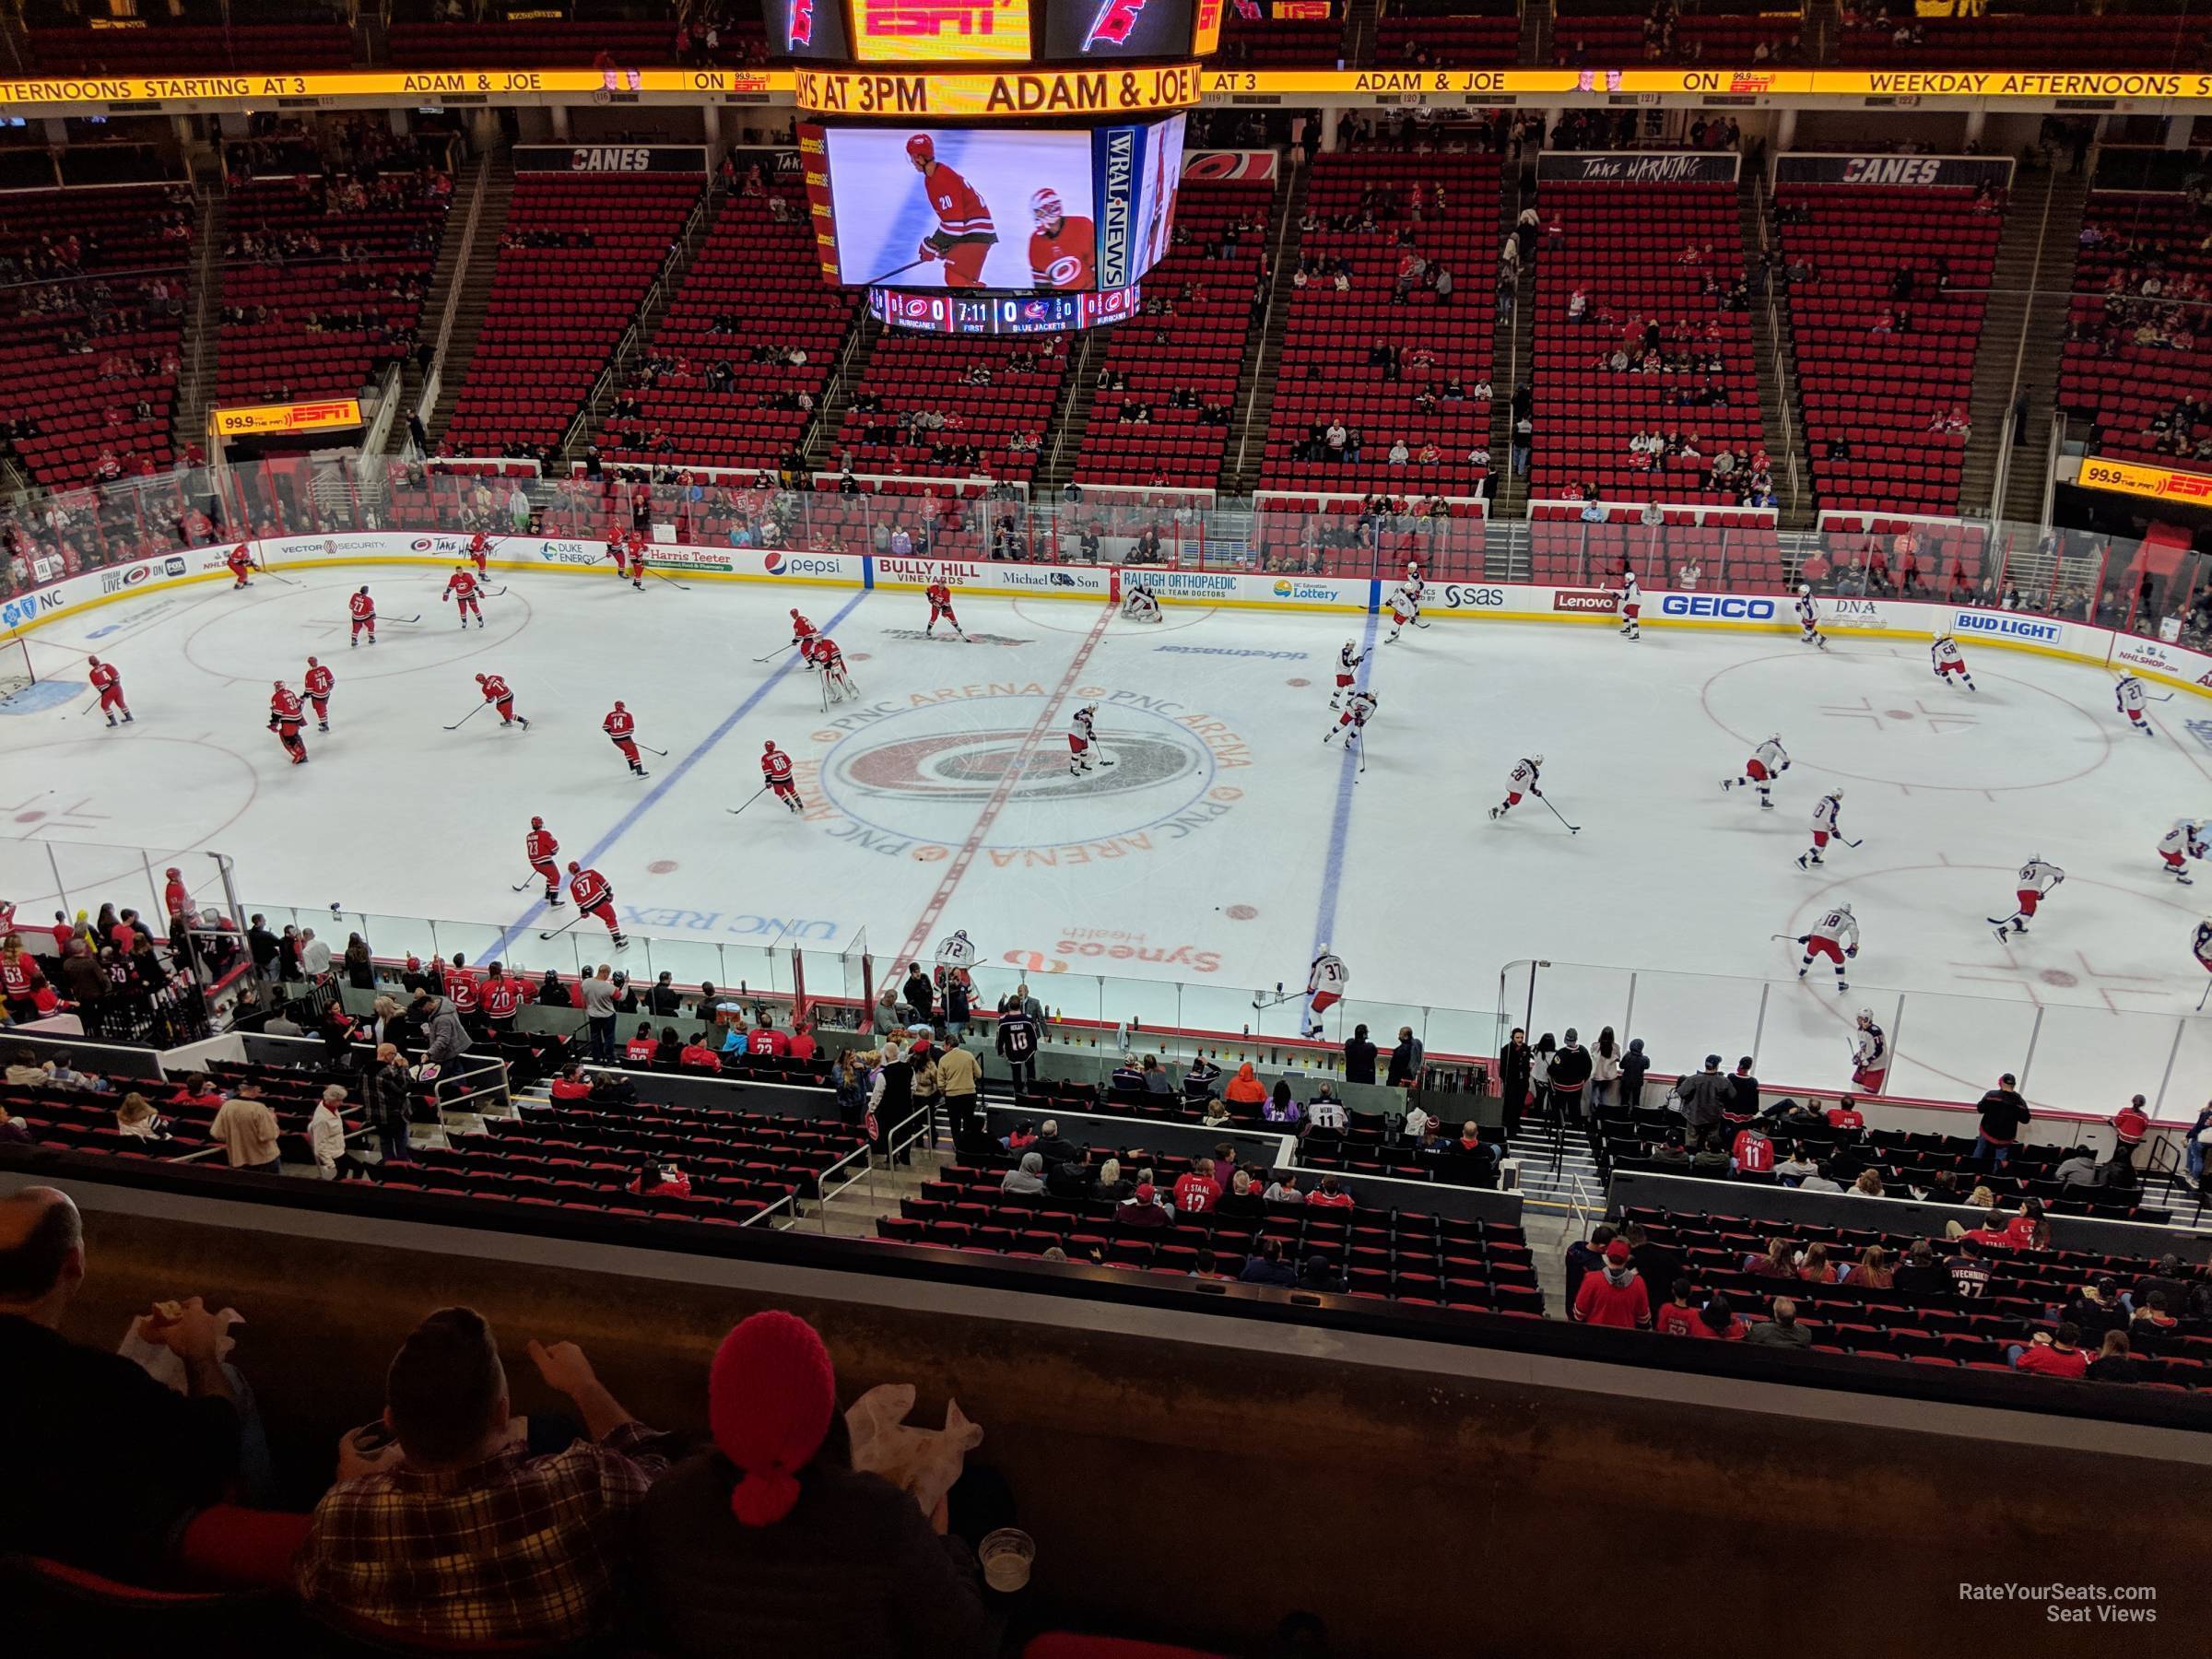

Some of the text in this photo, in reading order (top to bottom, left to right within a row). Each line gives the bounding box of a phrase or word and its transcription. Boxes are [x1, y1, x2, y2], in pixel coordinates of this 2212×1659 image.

[145, 78, 250, 97] STARTING
[263, 77, 287, 95] AT
[293, 77, 306, 94] 3
[404, 74, 542, 91] ADAM & JOE
[695, 74, 724, 88] ON
[1214, 73, 1505, 90] AT 3 ADAM & JOE
[1684, 73, 1719, 90] ON
[1870, 75, 1990, 92] WEEKDAY
[2001, 76, 2182, 95] AFTERNOONS
[596, 92, 608, 101] 116
[824, 76, 850, 110] AT
[858, 76, 927, 112] 3PM
[986, 74, 1107, 112] ADAM
[1119, 72, 1141, 108] &
[1148, 68, 1188, 107] JOE
[1208, 95, 1221, 103] 119
[1404, 94, 1418, 103] 120
[1641, 94, 1655, 103] 121
[1899, 95, 1914, 105] 122
[572, 149, 650, 171] CANES
[775, 152, 803, 171] TAK
[1107, 133, 1132, 203] WRAL
[1583, 156, 1704, 182] TAKE WARNING
[1842, 159, 1941, 185] CANES
[938, 195, 952, 210] 20
[1106, 207, 1125, 286] NEWS
[933, 300, 944, 321] 0
[959, 303, 987, 323] 7:11
[1005, 302, 1018, 322] 0
[1065, 302, 1072, 316] 0
[899, 319, 935, 330] HURRICANES
[1013, 321, 1066, 332] BLUE JACKETS
[1097, 312, 1126, 325] HURRICANES
[963, 324, 983, 333] FIRST
[292, 404, 350, 423] ESPN
[225, 416, 254, 429] 99.9
[2088, 468, 2122, 485] 99.9
[282, 541, 386, 555] VECTOR SECURITY
[433, 537, 456, 552] TAKE
[559, 543, 582, 554] DUKE
[559, 552, 596, 564] ENERGY
[651, 549, 731, 564] Harris Teeter
[791, 555, 840, 574] pepsi
[153, 564, 164, 576] ON
[166, 559, 184, 573] FOX
[880, 559, 981, 578] BULLY HILL
[101, 571, 121, 582] STREAM
[898, 574, 964, 585] VINEYARDS
[1003, 571, 1048, 586] Michael
[1077, 575, 1099, 588] Son
[1124, 572, 1237, 591] RALEIGH ORTHOPAEDIC
[103, 580, 122, 594] LIVE
[1169, 588, 1189, 597] TEAM
[1191, 590, 1226, 598] DOCTORS
[1293, 588, 1339, 602] Lottery
[41, 589, 65, 611] NC
[354, 600, 364, 613] 27
[1559, 594, 1613, 609] Lenovo
[1662, 595, 1775, 619] GEICO
[1835, 600, 1877, 615] DNA
[1958, 615, 2059, 641] BUD LIGHT
[1152, 645, 1310, 661] ticketmaster
[315, 676, 328, 690] 74
[2126, 685, 2142, 700] 27
[830, 681, 1049, 732] PNC ARENA
[613, 716, 624, 729] 14
[1107, 688, 1254, 771] PNC ARENA
[772, 757, 786, 771] 86
[1511, 766, 1527, 782] 28
[824, 825, 915, 857] PNC
[986, 799, 1231, 868] PNC ARENA
[527, 841, 537, 856] 23
[575, 878, 590, 898] 37
[618, 906, 839, 941] UNC REX
[1822, 913, 1841, 928] 18
[1062, 927, 1147, 946] Health
[199, 940, 216, 954] 74
[945, 942, 962, 959] 72
[1055, 939, 1222, 975] Syneos
[5, 967, 24, 983] 53
[1324, 963, 1342, 981] 37
[450, 985, 469, 1003] 12
[492, 994, 510, 1009] 20
[1010, 1032, 1028, 1052] 10
[1319, 1115, 1334, 1127] 11
[1745, 1146, 1759, 1168] 11
[1186, 1194, 1205, 1212] 12
[1951, 1269, 1989, 1282] SVECHNIKO
[1958, 1280, 1983, 1298] 37
